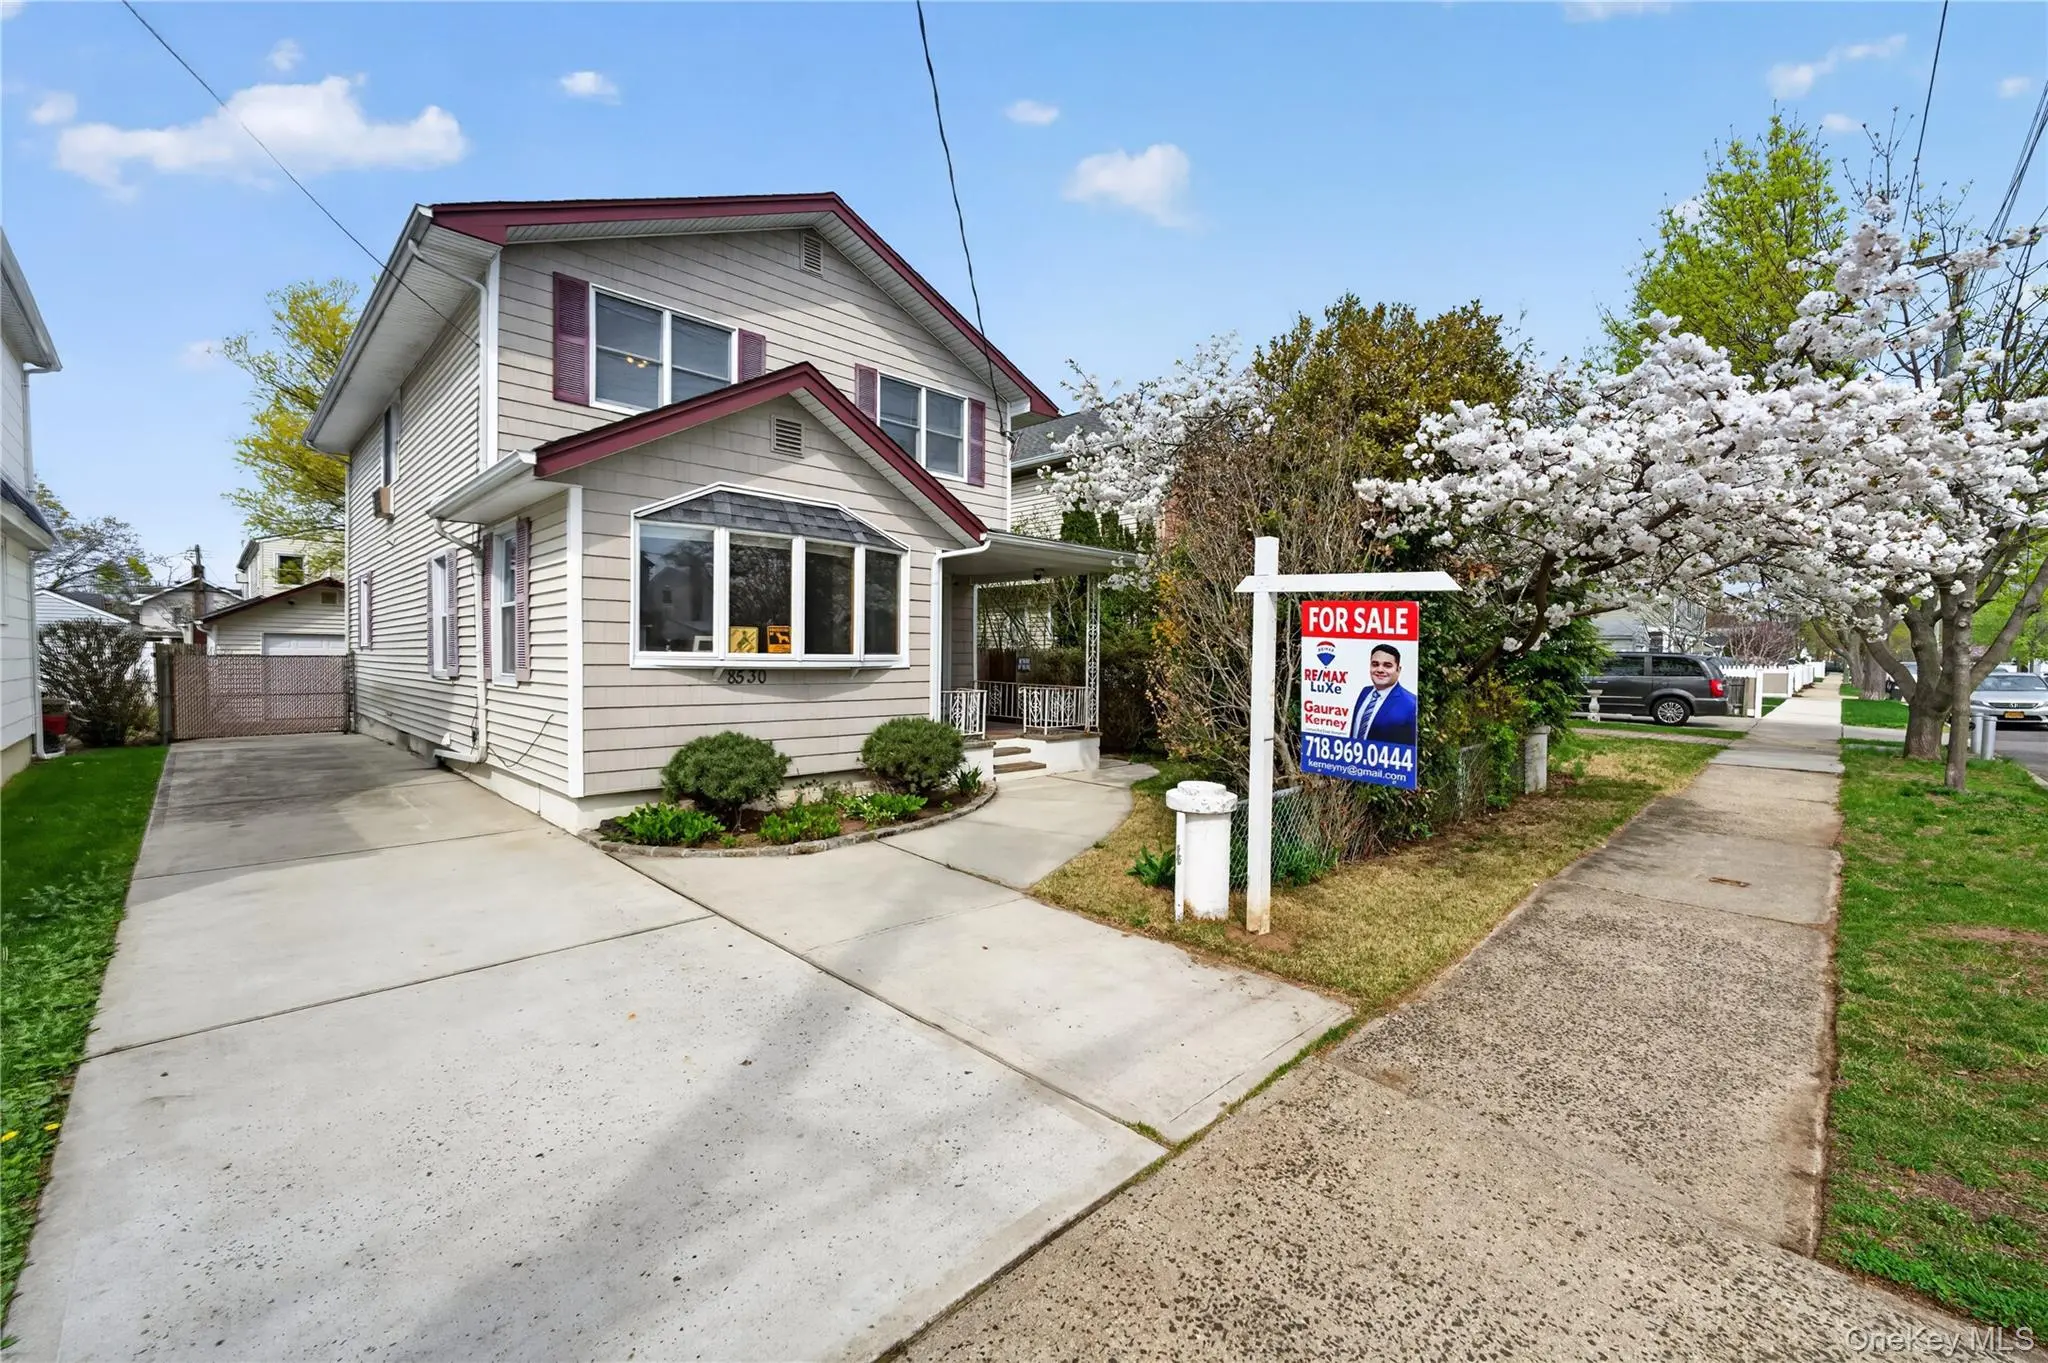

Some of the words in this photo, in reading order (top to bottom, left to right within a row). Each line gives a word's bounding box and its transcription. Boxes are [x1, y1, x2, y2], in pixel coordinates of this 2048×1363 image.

[1309, 607, 1348, 632] FOR
[1354, 608, 1408, 634] SALE
[727, 669, 767, 684] 8530
[1304, 669, 1349, 684] RE/MAX
[1310, 682, 1342, 695] LuXe
[1304, 701, 1349, 717] Gaurav
[1305, 714, 1347, 730] Kerney
[1305, 735, 1413, 772] 718.969.0444
[1308, 759, 1407, 782] kerneyny@gmail.com
